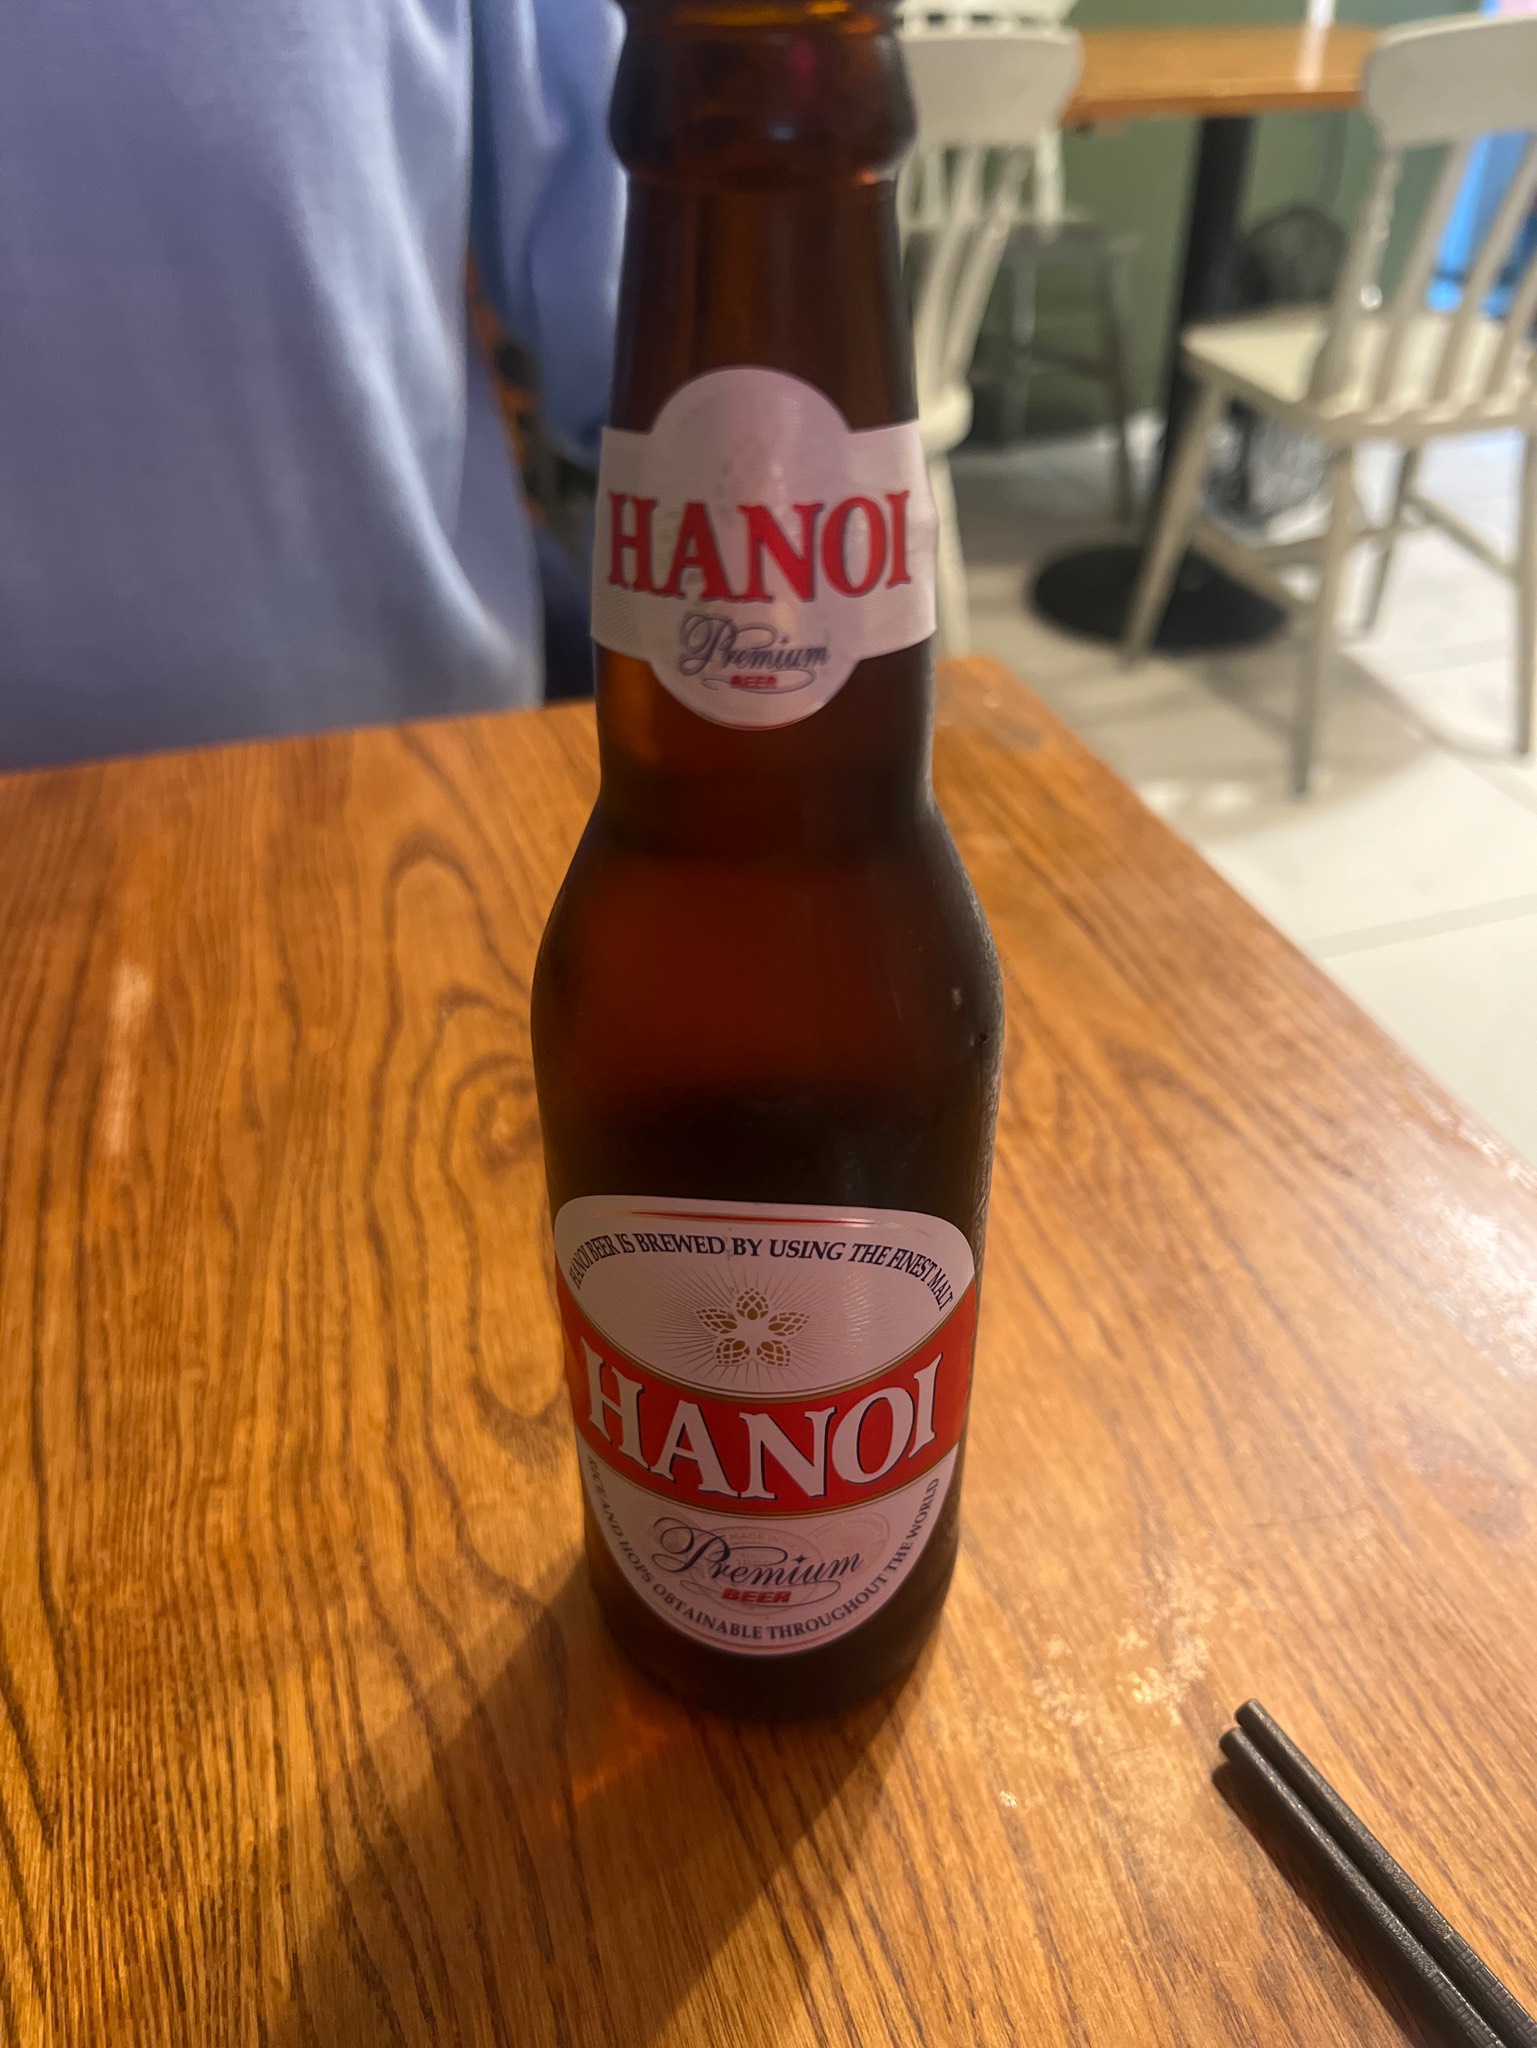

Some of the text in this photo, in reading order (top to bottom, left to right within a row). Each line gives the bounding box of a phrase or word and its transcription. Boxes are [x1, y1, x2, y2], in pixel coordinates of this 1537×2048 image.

[608, 489, 911, 603] HANOI
[678, 613, 830, 676] Premium
[729, 675, 778, 689] BEER
[569, 1233, 954, 1311] HANOI BEER IS BREWED BY USING THE FINEST MALT
[580, 1337, 943, 1501] HANOI
[600, 1498, 624, 1537] AND
[619, 1540, 655, 1583] HOPS
[653, 1583, 763, 1640] OBTAINABLE
[767, 1573, 888, 1640] THROUGHOUT
[883, 1540, 914, 1575] THE
[906, 1478, 940, 1541] WORLD
[652, 1516, 864, 1587] Premium
[721, 1587, 792, 1603] BEER
